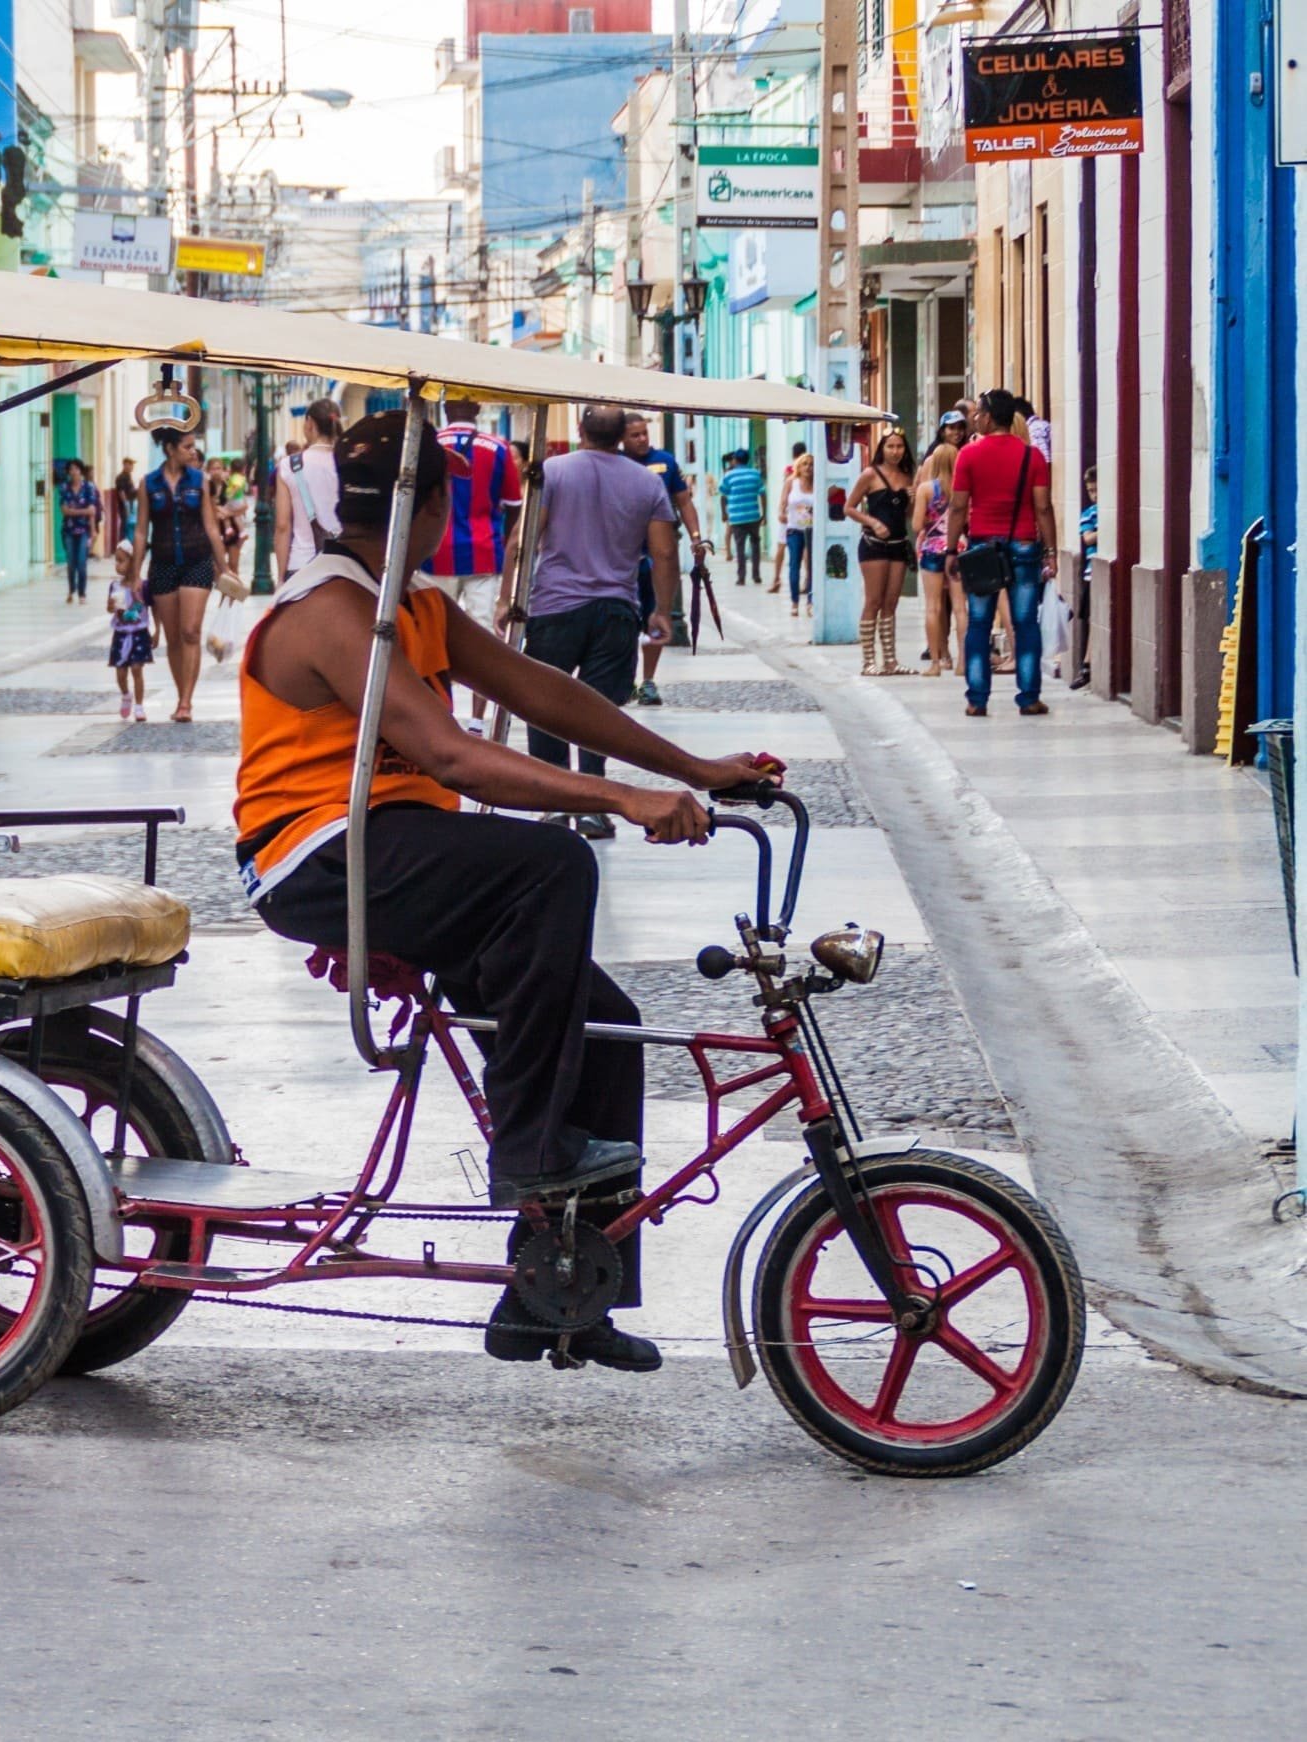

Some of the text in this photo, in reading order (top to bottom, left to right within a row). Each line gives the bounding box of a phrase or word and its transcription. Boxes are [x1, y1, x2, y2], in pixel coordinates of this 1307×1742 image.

[977, 48, 1125, 74] CELULARES
[1042, 73, 1067, 99] &
[998, 98, 1109, 123] JOYERIA
[1059, 124, 1128, 142] Soluciones
[973, 136, 1036, 152] TALLER
[1048, 140, 1140, 157] Garantizadas
[736, 152, 750, 162] LA
[733, 186, 814, 199] Panamericana
